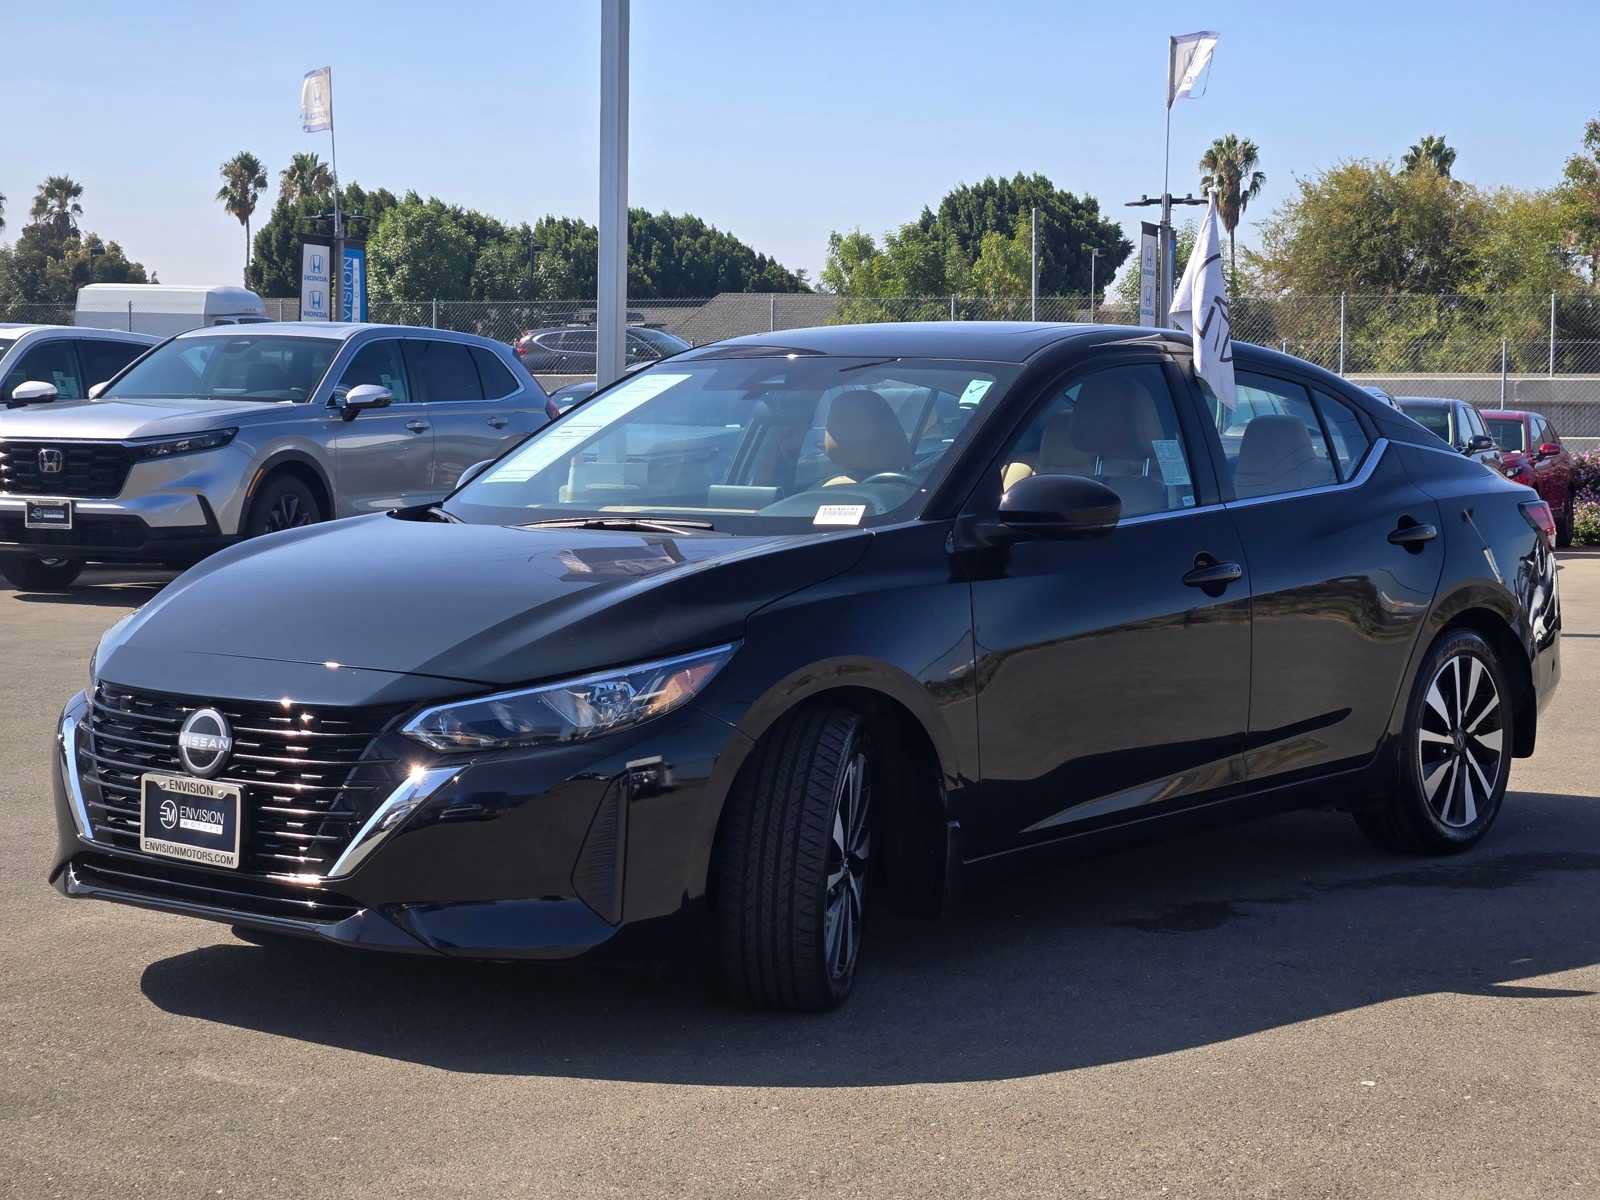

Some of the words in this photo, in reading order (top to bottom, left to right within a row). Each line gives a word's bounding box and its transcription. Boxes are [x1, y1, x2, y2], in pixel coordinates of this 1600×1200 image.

[304, 274, 328, 282] HONDA
[303, 310, 328, 318] HONDA
[180, 733, 230, 750] NISSAN
[169, 779, 214, 796] ENVISION
[180, 806, 224, 825] ENVISION
[144, 840, 234, 866] ENVISIONMOTORS.COM
